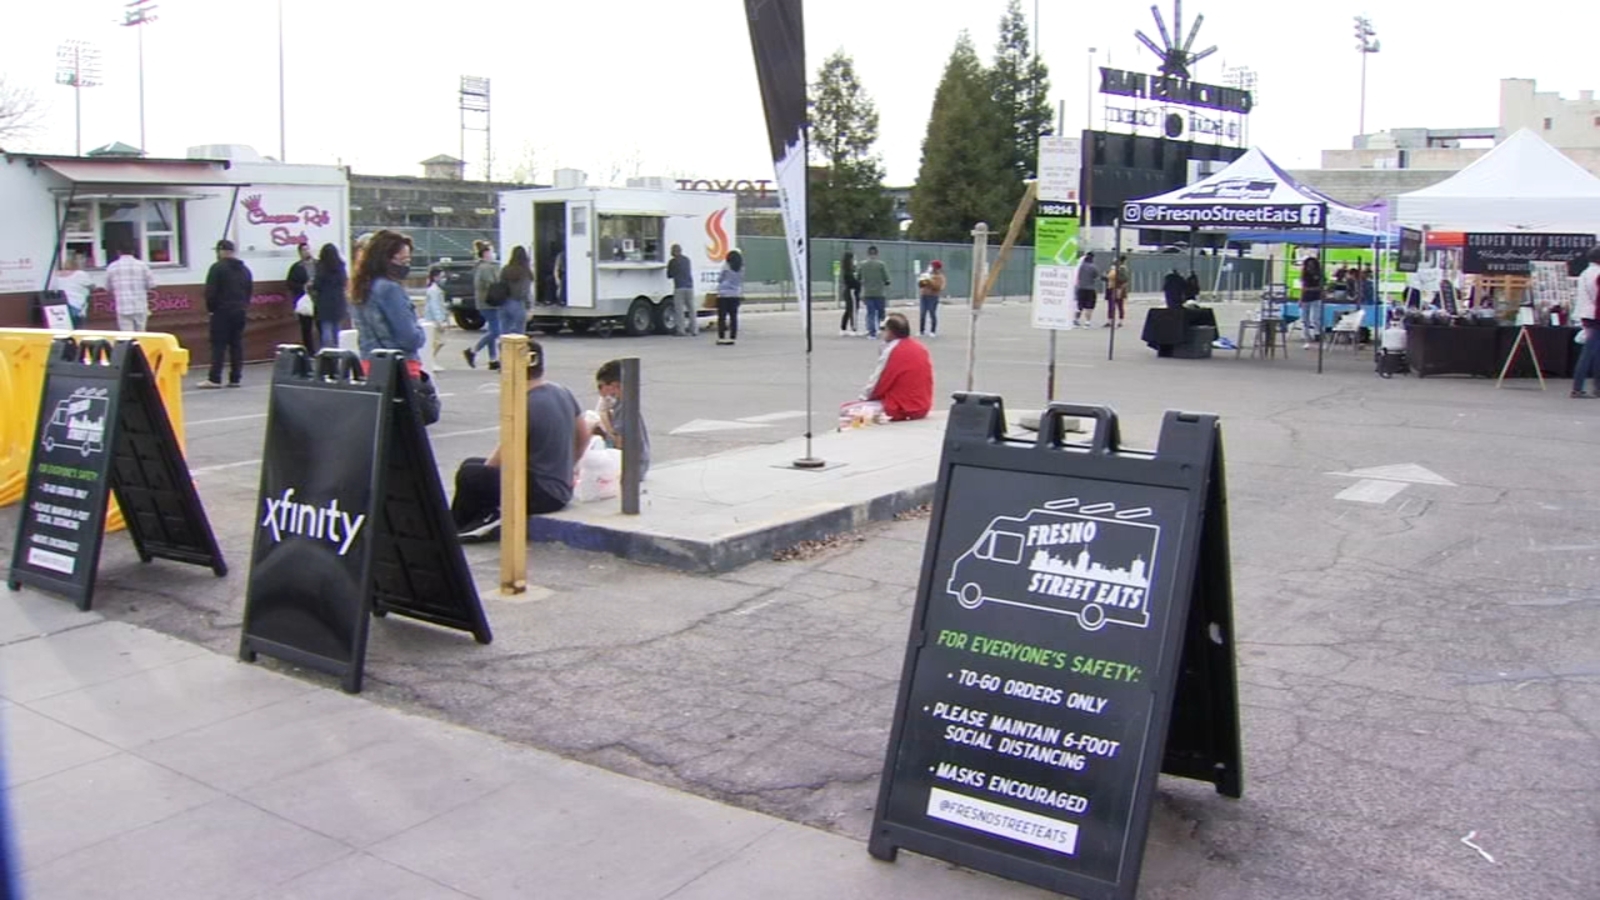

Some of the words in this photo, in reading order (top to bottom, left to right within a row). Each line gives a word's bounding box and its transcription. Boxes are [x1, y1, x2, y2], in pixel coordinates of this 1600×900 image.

[1143, 205, 1299, 222] @FresnoStreetEats
[264, 488, 365, 555] xfinity
[1026, 521, 1096, 546] FRESNO
[1027, 572, 1096, 601] STREET
[1093, 582, 1144, 609] EATS
[937, 630, 967, 650] FOR
[971, 637, 1066, 669] EVERYONE'S
[1070, 655, 1143, 683] SAFETY:
[958, 669, 1001, 692] TO-GO
[1003, 679, 1064, 705] ORDERS
[1066, 692, 1108, 714] ONLY
[932, 702, 988, 728] PLEASE
[989, 714, 1061, 744] MAINTAIN
[1062, 732, 1121, 758] 6-FOOT
[943, 725, 993, 750] SOCIAL
[998, 737, 1087, 771] DISTANCING
[935, 762, 986, 788] MASKS
[988, 775, 1089, 814] ENCOURAGED
[938, 799, 1068, 845] @FRESNOSTREETEATS
